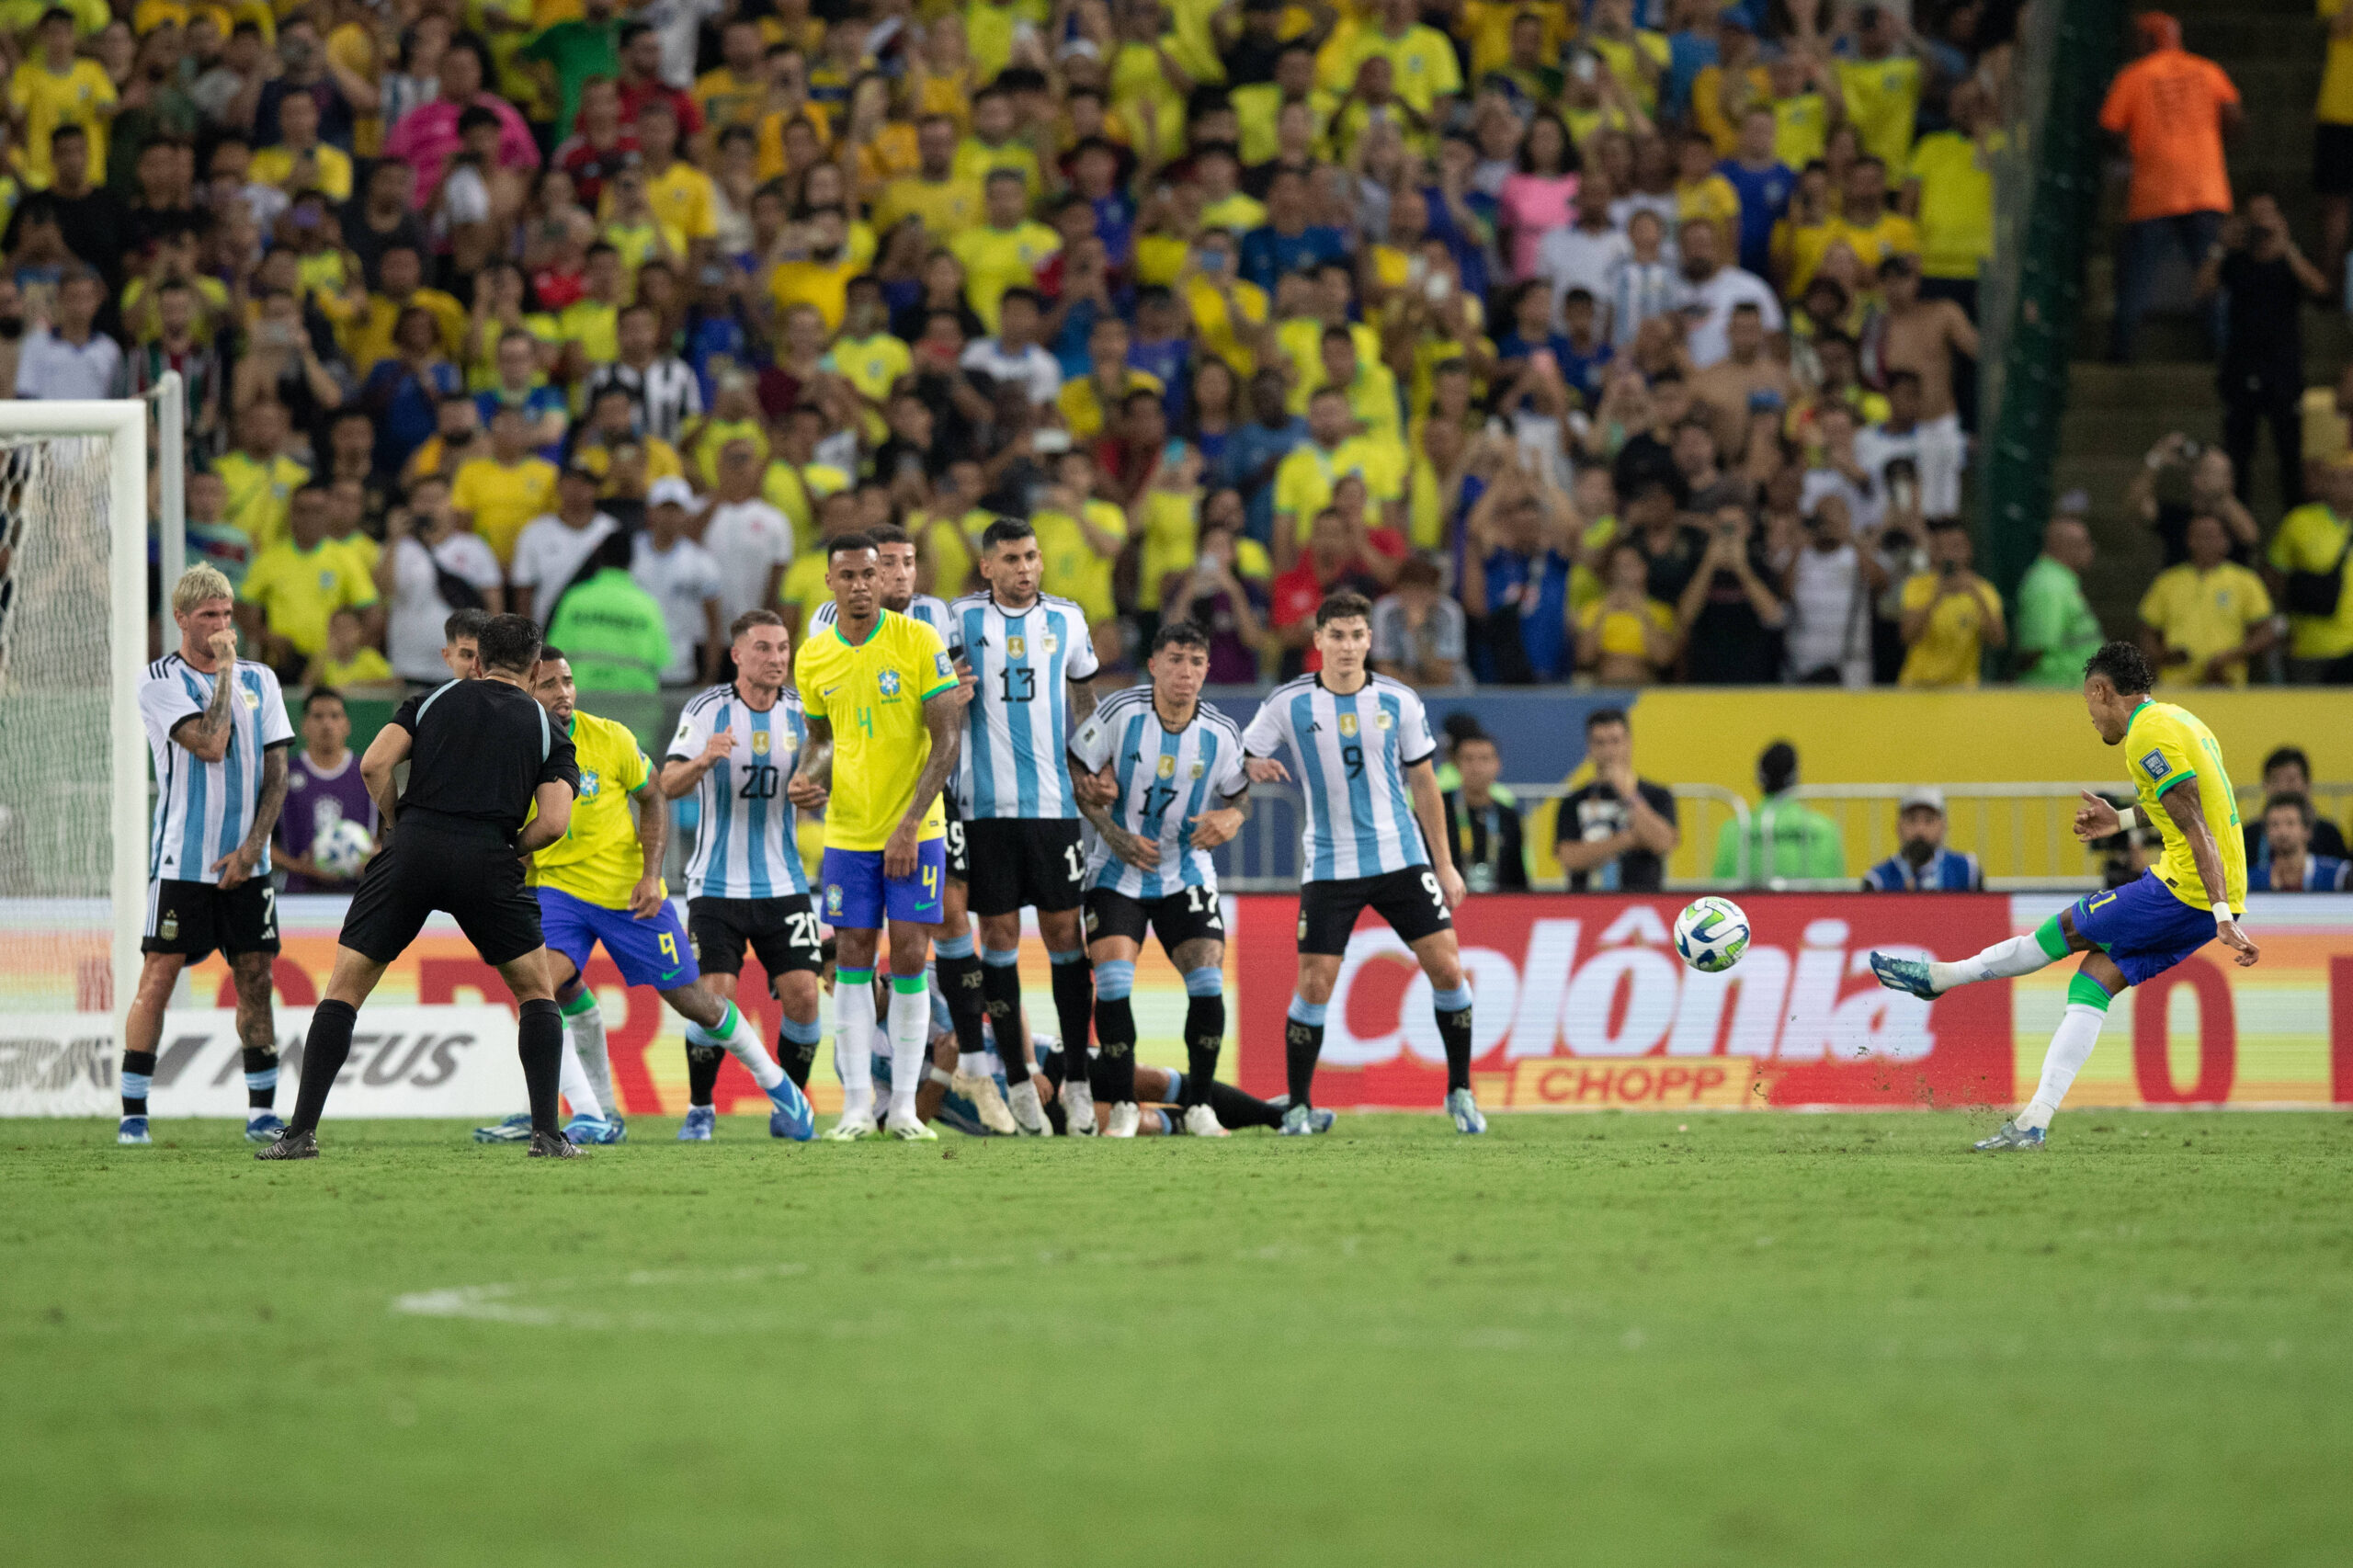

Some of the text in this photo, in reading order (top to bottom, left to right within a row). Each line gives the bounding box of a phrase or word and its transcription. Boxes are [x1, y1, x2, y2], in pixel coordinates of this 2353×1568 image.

[999, 667, 1035, 702] 13
[857, 707, 873, 738] 4
[1343, 746, 1363, 778] 9
[739, 765, 779, 799] 20
[1138, 785, 1178, 818] 17
[922, 864, 938, 899] 4
[1421, 871, 1442, 906] 9
[262, 887, 275, 925] 7
[1186, 884, 1220, 914] 17
[785, 911, 822, 948] 20
[658, 931, 679, 964] 9
[1538, 1066, 1726, 1102] CHOPP
